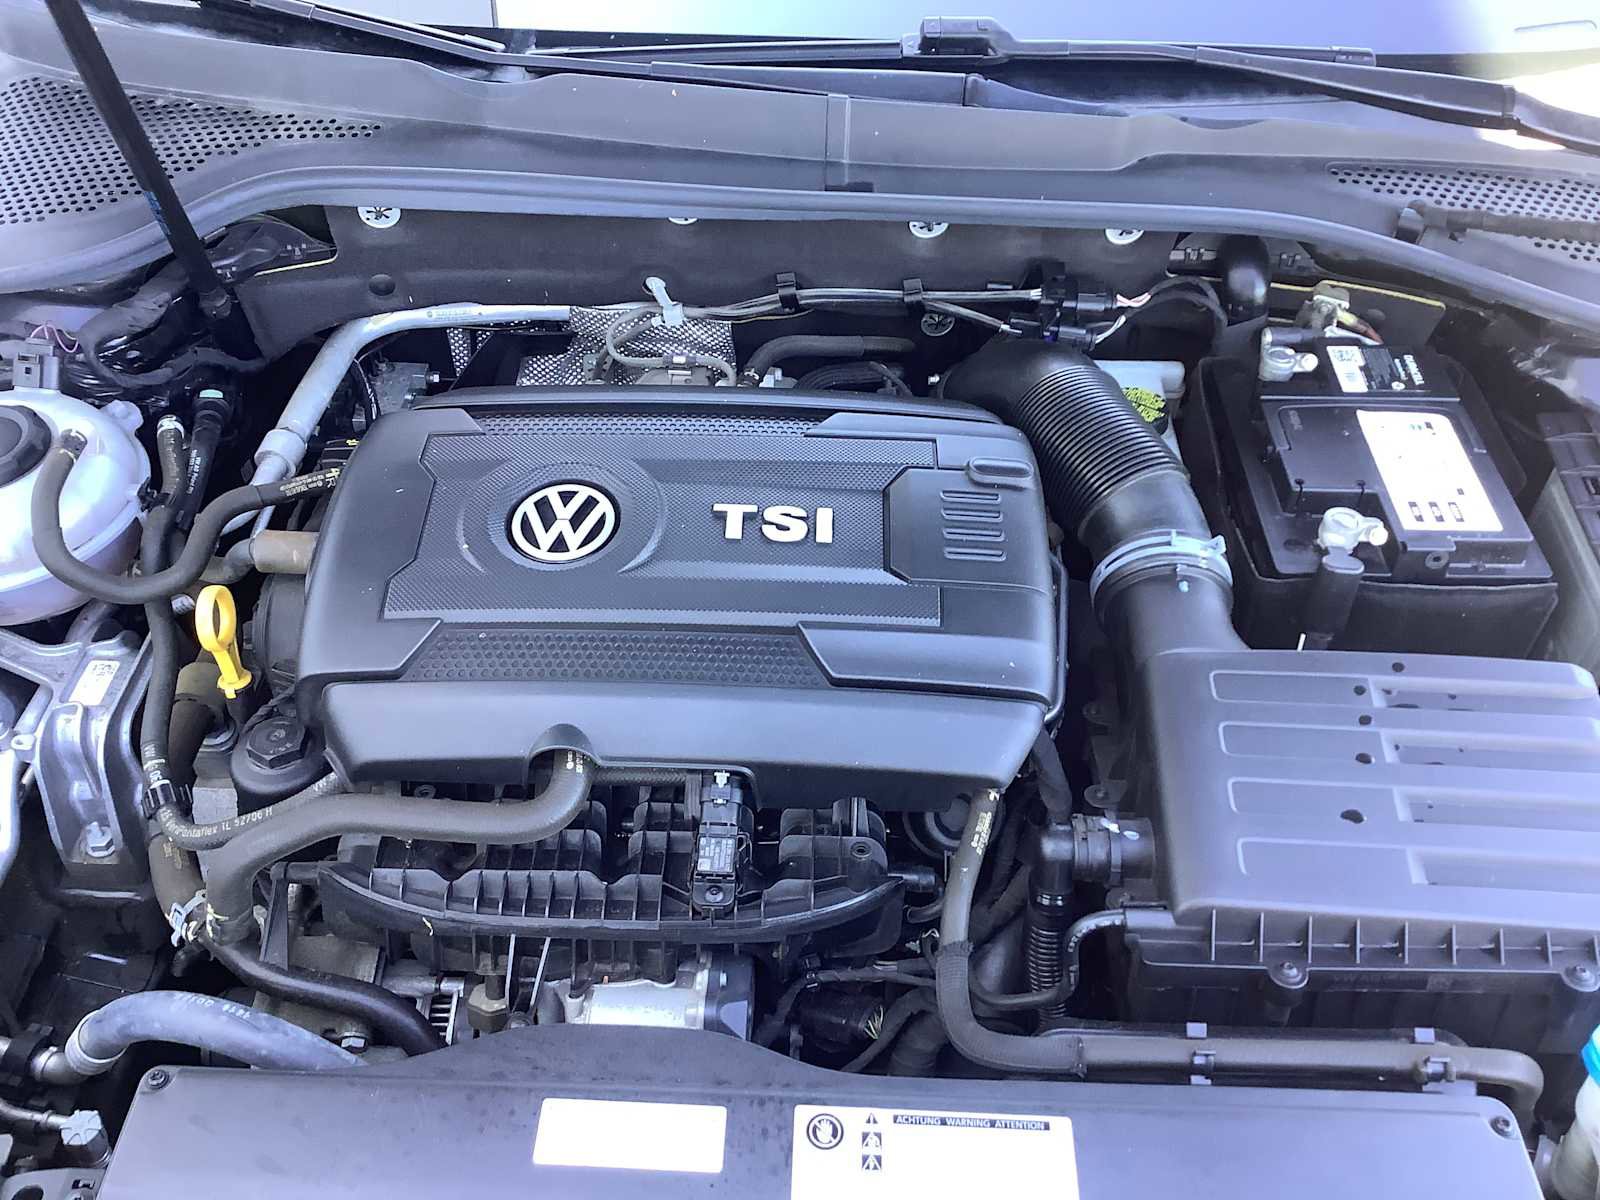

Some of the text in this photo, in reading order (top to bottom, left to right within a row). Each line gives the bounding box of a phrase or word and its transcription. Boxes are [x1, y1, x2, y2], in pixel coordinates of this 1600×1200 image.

[712, 503, 835, 544] TSI
[896, 1115, 1046, 1131] ACHTUNG WARNING ATTENTION
